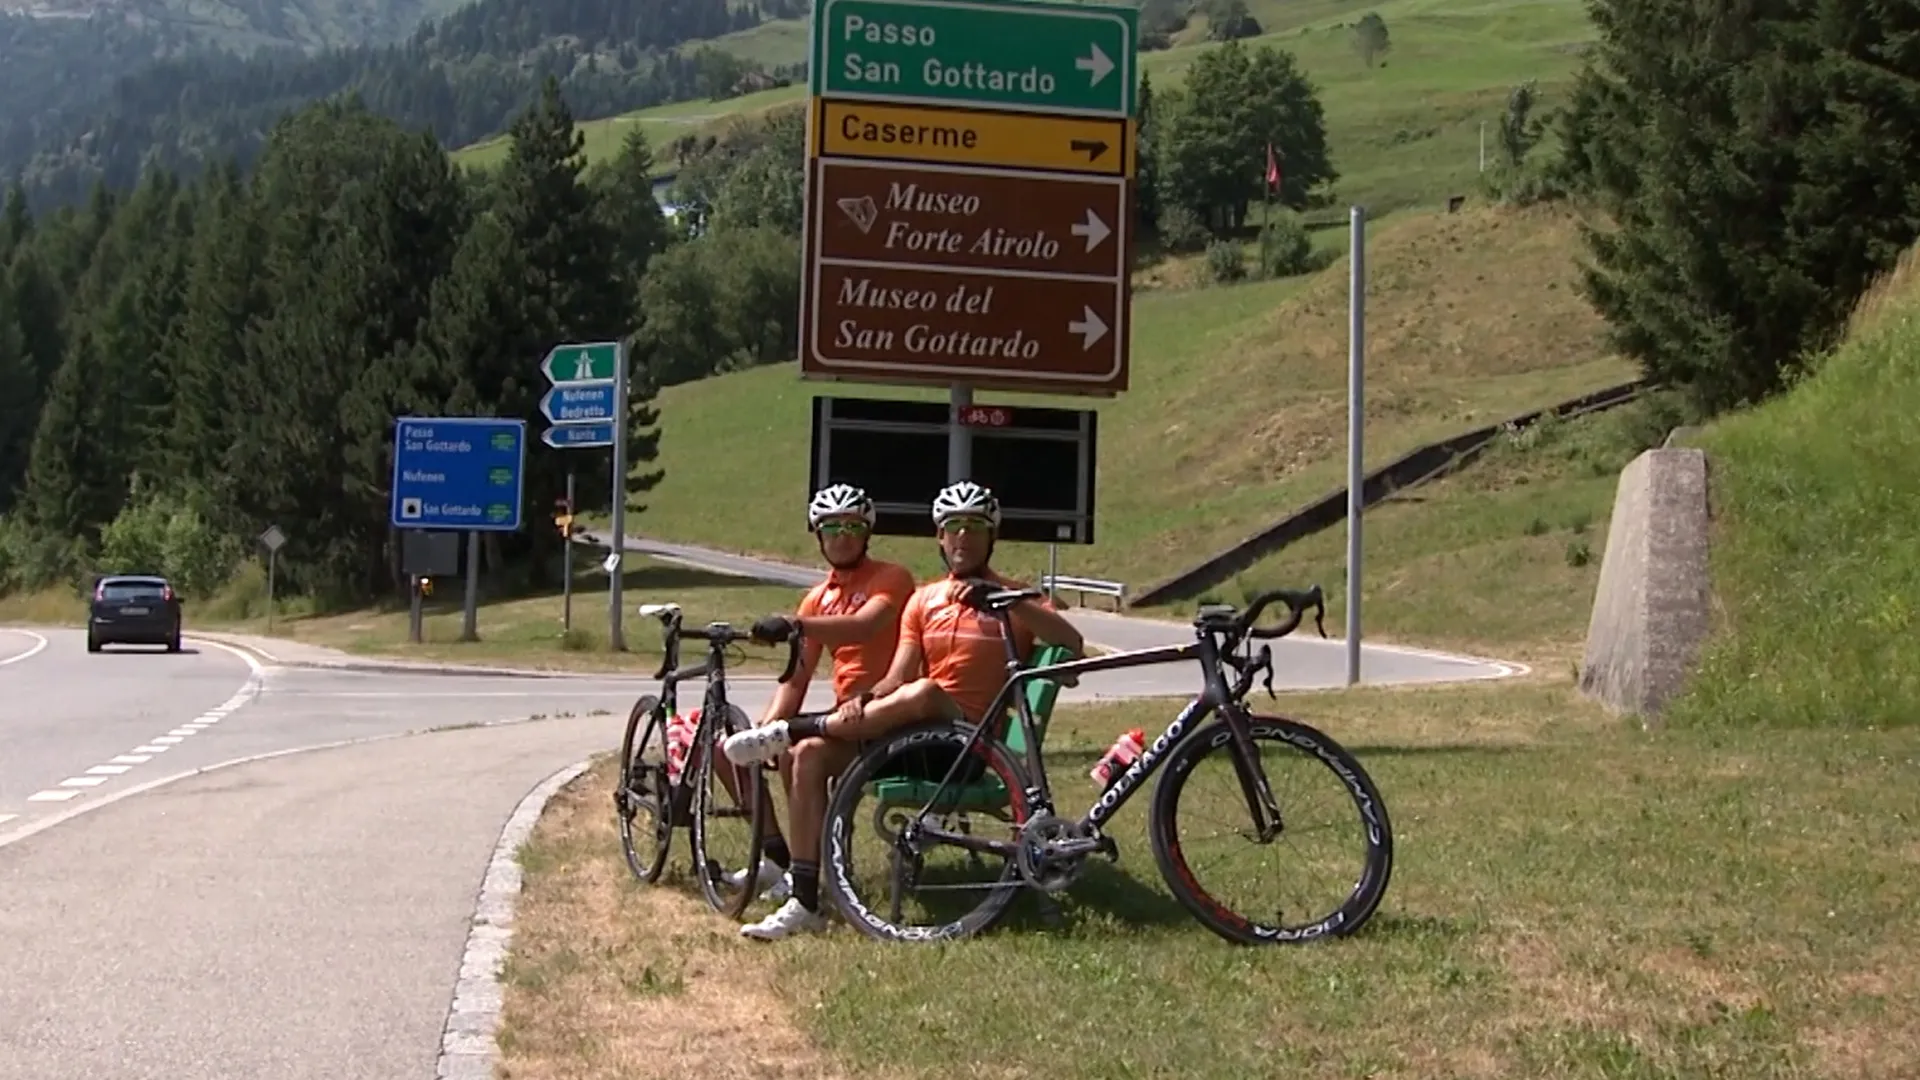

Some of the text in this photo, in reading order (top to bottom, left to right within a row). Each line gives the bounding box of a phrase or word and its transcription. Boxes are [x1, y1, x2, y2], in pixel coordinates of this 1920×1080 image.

[844, 15, 936, 46] Passo
[844, 54, 1056, 95] San Gottardo
[841, 114, 978, 149] Caserme
[885, 182, 981, 216] Museo
[885, 221, 1060, 259] Forte Airolo
[837, 277, 994, 314] Museo del
[835, 319, 1041, 359] San Gottardo
[562, 389, 605, 402] Nufenen
[404, 425, 434, 438] Passo
[404, 440, 473, 452] San Gottardo
[402, 470, 446, 482] Nufenen
[422, 503, 482, 516] San Gottardo
[1089, 720, 1184, 821] COLNAGO
